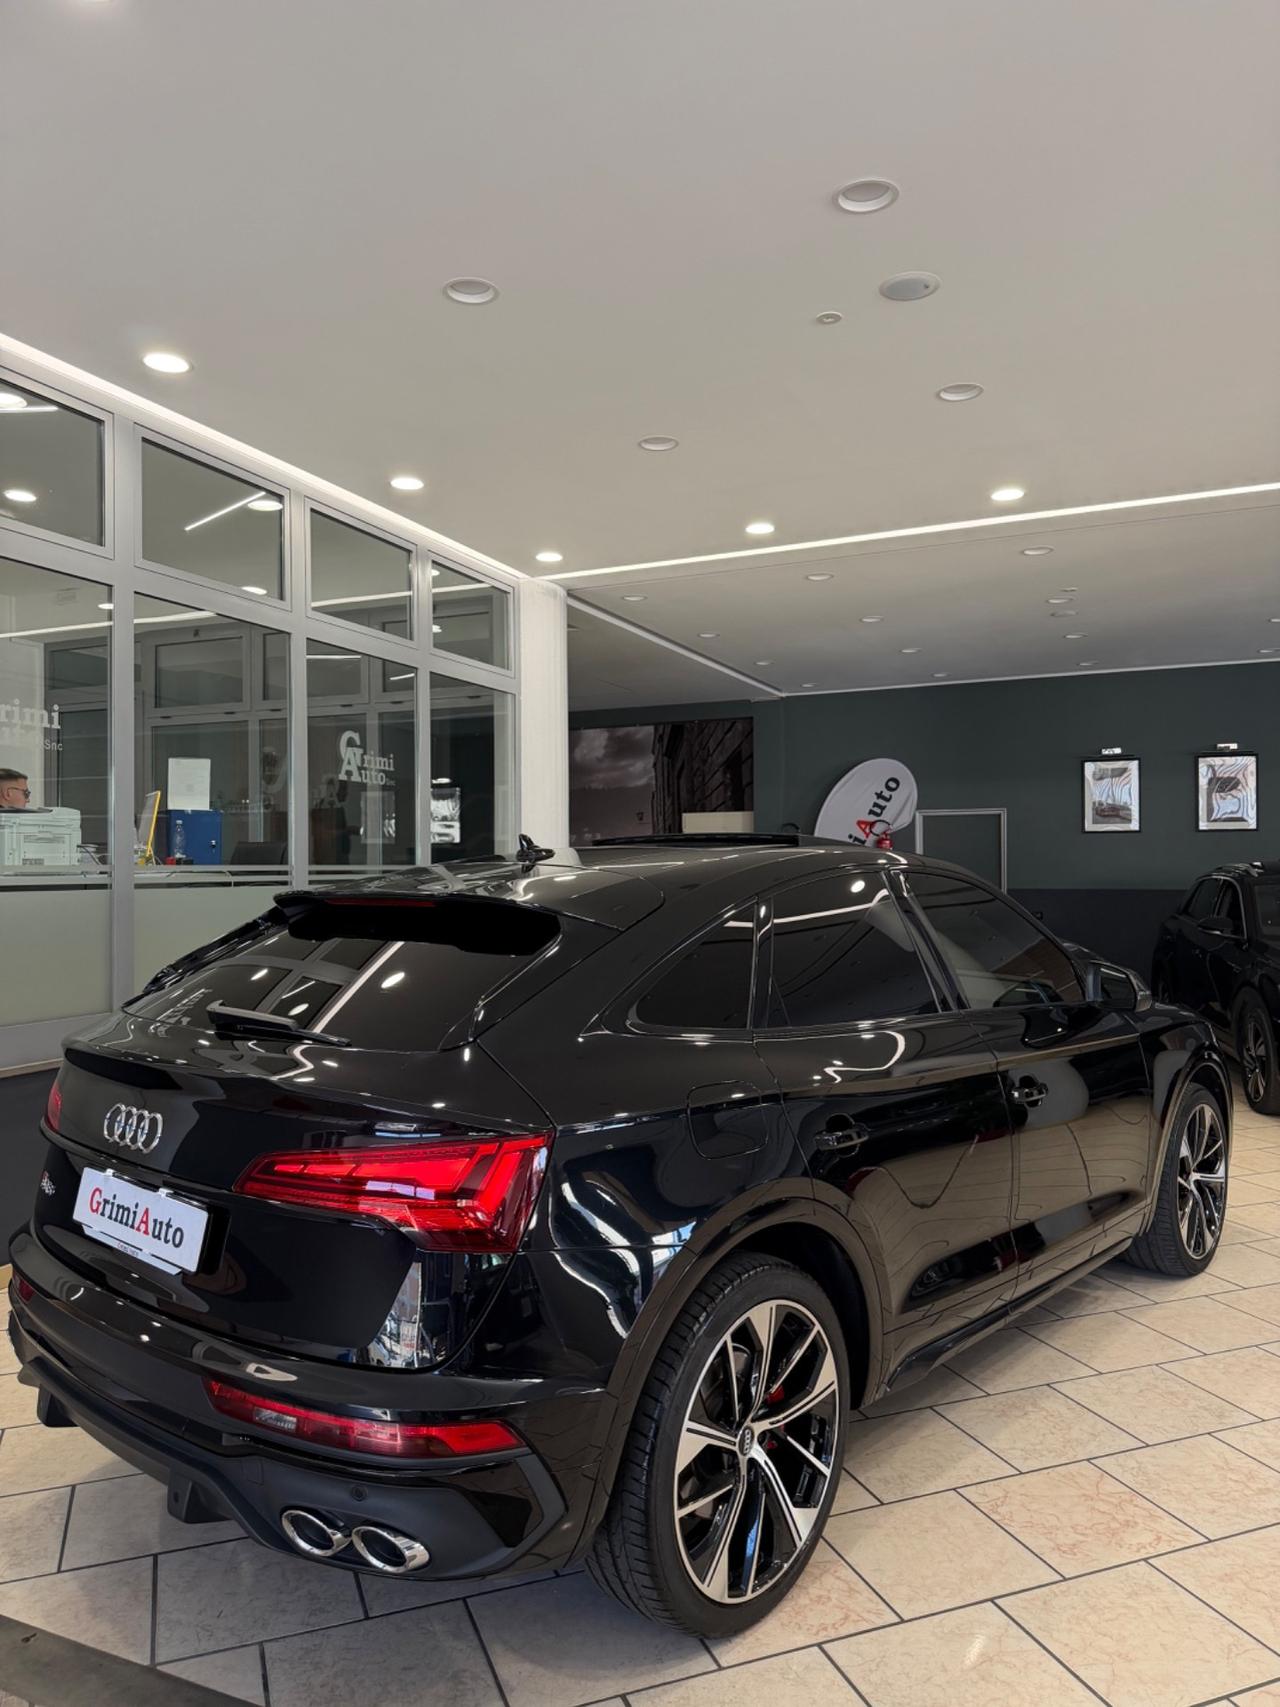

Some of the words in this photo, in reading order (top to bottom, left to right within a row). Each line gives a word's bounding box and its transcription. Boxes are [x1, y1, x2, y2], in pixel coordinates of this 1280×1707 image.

[44, 739, 63, 751] Snc
[339, 747, 386, 785] Auto
[89, 1187, 184, 1248] GrimiAuto
